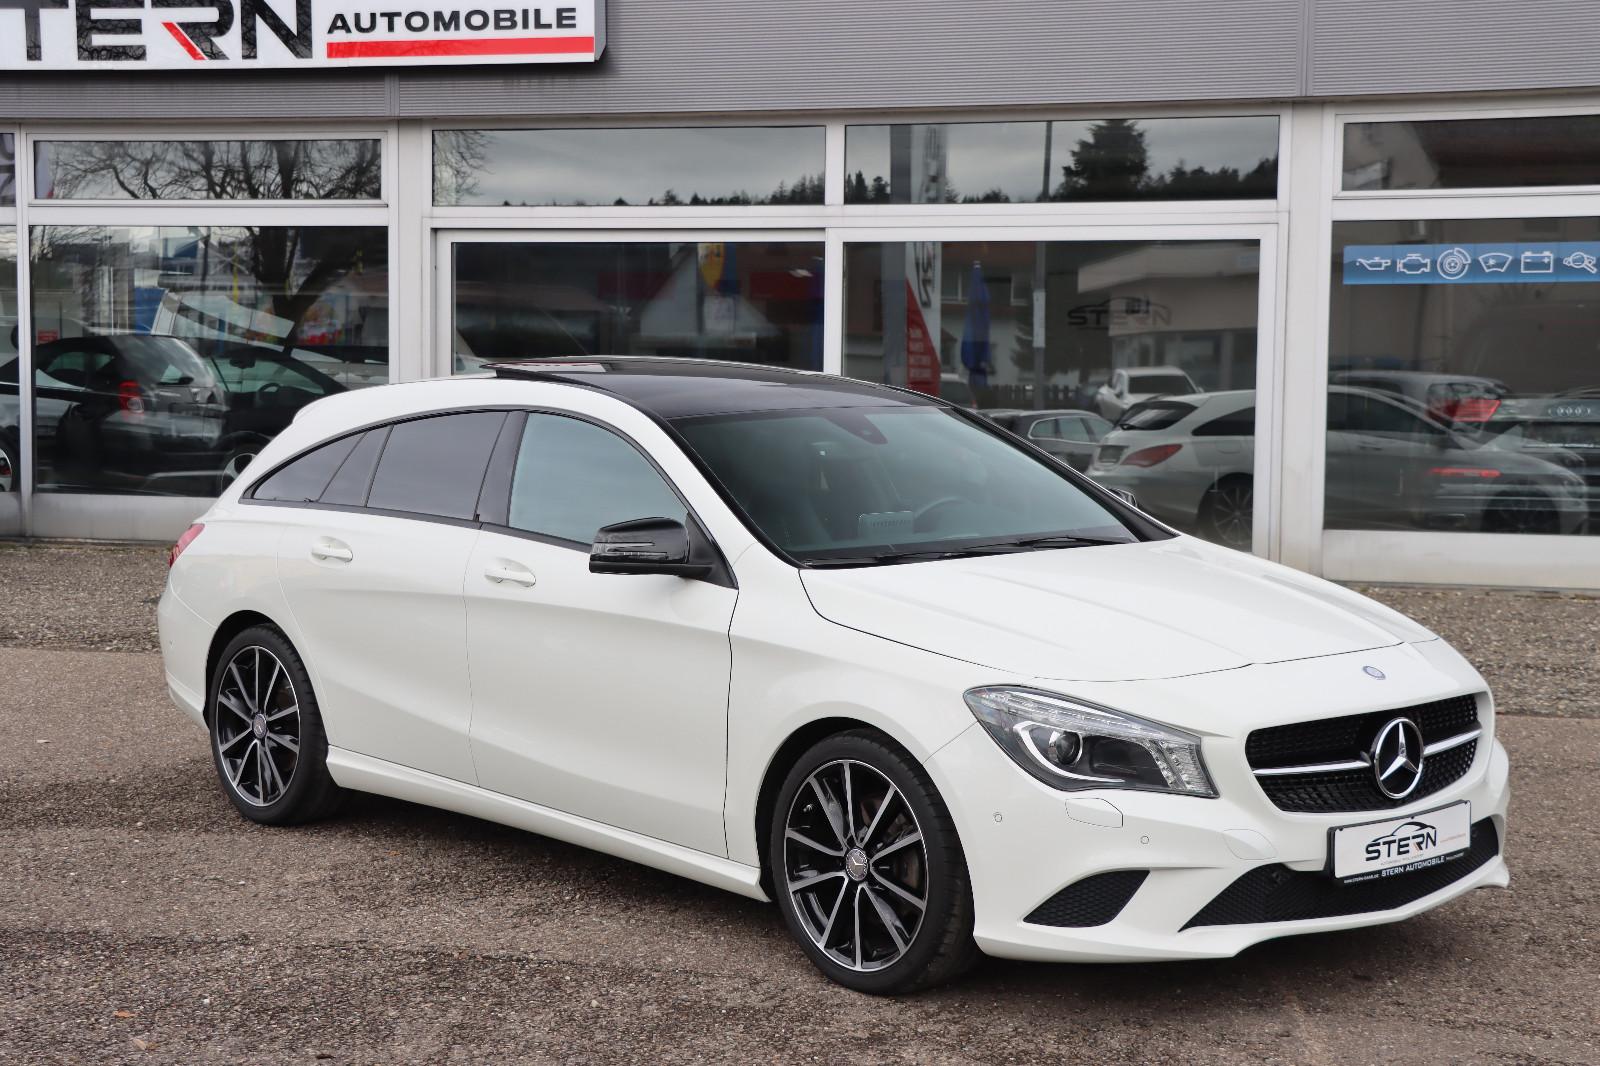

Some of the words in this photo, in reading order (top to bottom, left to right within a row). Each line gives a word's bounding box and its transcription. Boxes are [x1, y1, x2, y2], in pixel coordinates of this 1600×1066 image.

[327, 7, 577, 35] AUTOMOBILE
[1365, 829, 1437, 862] STERN
[1381, 866, 1405, 877] STERN
[1405, 855, 1445, 872] AUTOMOBILE
